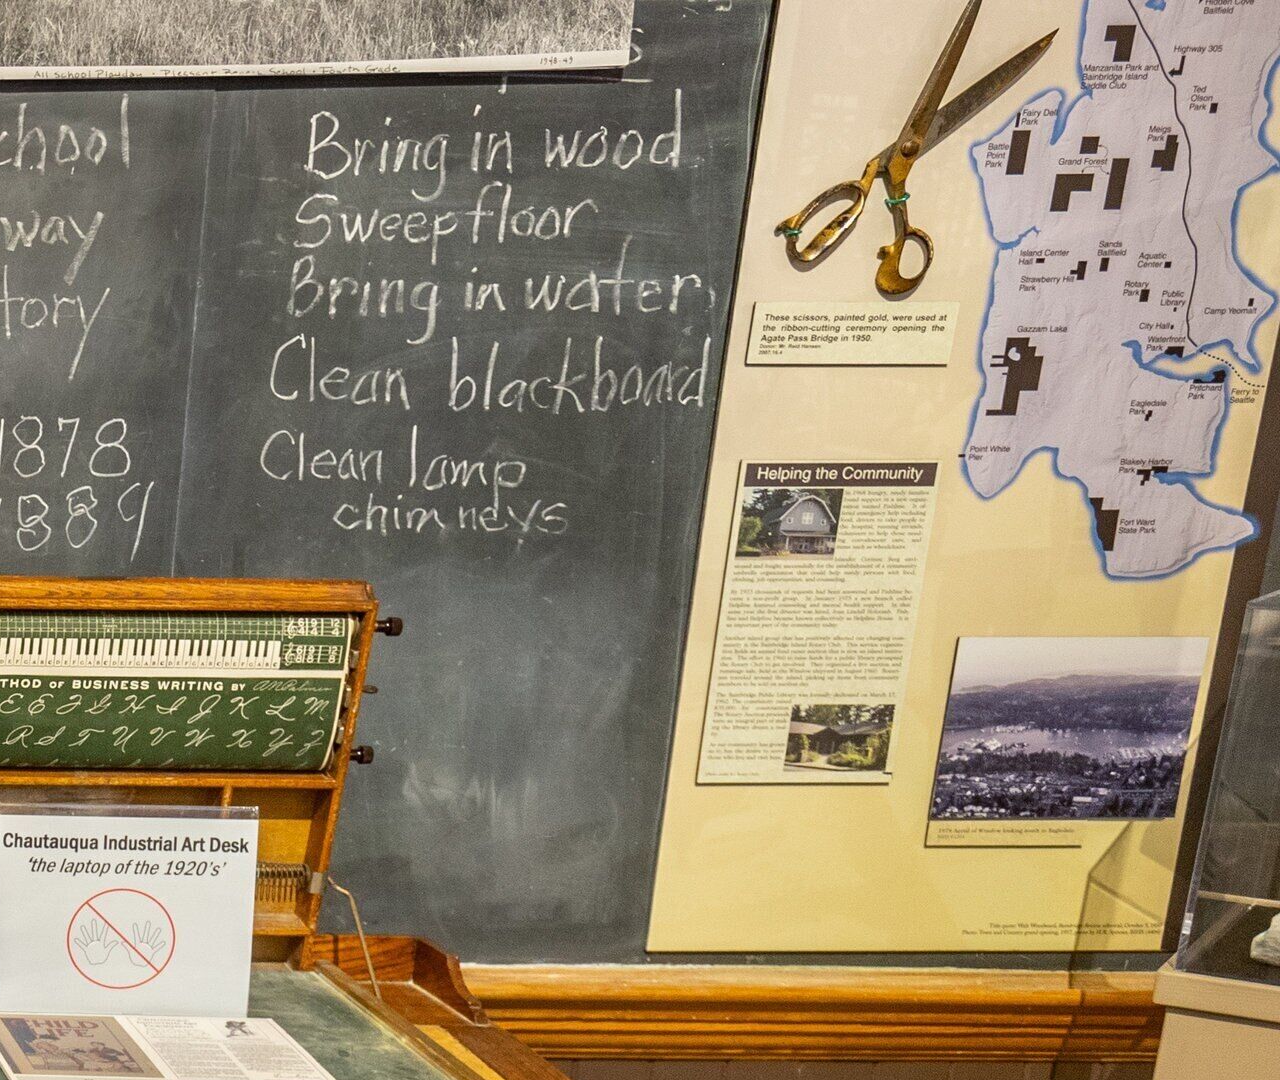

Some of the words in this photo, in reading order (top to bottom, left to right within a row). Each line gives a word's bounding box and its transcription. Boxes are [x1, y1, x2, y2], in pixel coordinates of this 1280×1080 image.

[1173, 44, 1206, 54] Highway
[1207, 45, 1223, 53] 305
[1083, 64, 1123, 72] Manzanita
[1124, 64, 1142, 72] Park
[1142, 64, 1159, 72] and
[1081, 73, 1123, 82] Bainbridge
[1124, 73, 1148, 81] Island
[1080, 81, 1107, 90] Saddle
[1108, 81, 1127, 90] Club
[305, 110, 446, 202] Bring
[471, 105, 513, 174] in
[545, 88, 683, 168] wood
[1058, 157, 1084, 166] Grand
[1086, 157, 1108, 166] Forest
[294, 194, 458, 265] Sweep
[468, 181, 599, 243] floor
[286, 255, 440, 344] Bring
[463, 266, 506, 312] in
[1161, 290, 1185, 299] Public
[1160, 299, 1186, 308] Library
[1203, 307, 1227, 316] Camp
[764, 313, 790, 322] These
[792, 313, 830, 323] scissors,
[833, 313, 865, 324] painted
[915, 313, 937, 322] used
[939, 314, 947, 322] at
[762, 324, 776, 332] the
[781, 324, 840, 334] ribbon-cutting
[845, 325, 887, 334] ceremony
[892, 325, 927, 334] opening
[931, 324, 945, 332] the
[1016, 325, 1048, 334] Gazzam
[1049, 325, 1068, 334] Lake
[1138, 322, 1153, 331] City
[1154, 322, 1171, 330] Hall
[761, 334, 785, 344] Agate
[787, 334, 808, 342] Pass
[810, 334, 838, 344] Bridge
[840, 334, 848, 342] in
[851, 334, 873, 342] 1950.
[269, 333, 410, 410] Clean
[450, 333, 711, 415] blackboard
[969, 445, 988, 453] Point
[989, 445, 1011, 453] White
[260, 430, 382, 482] Clean
[410, 425, 527, 491] lamp
[756, 466, 811, 483] Helping
[815, 466, 838, 480] the
[842, 466, 924, 483] Community
[1119, 518, 1135, 527] Fort
[1136, 518, 1156, 527] Ward
[1118, 526, 1138, 535] State
[1138, 526, 1157, 535] Park
[71, 679, 150, 690] BUSINESS
[157, 680, 224, 691] WRITING
[231, 683, 246, 691] BY
[2, 832, 99, 853] Chautauqua
[103, 834, 178, 852] Industrial
[181, 836, 206, 853] Art
[209, 837, 250, 854] Desk
[59, 858, 111, 877] laptop
[114, 859, 135, 875] of
[135, 860, 160, 875] the
